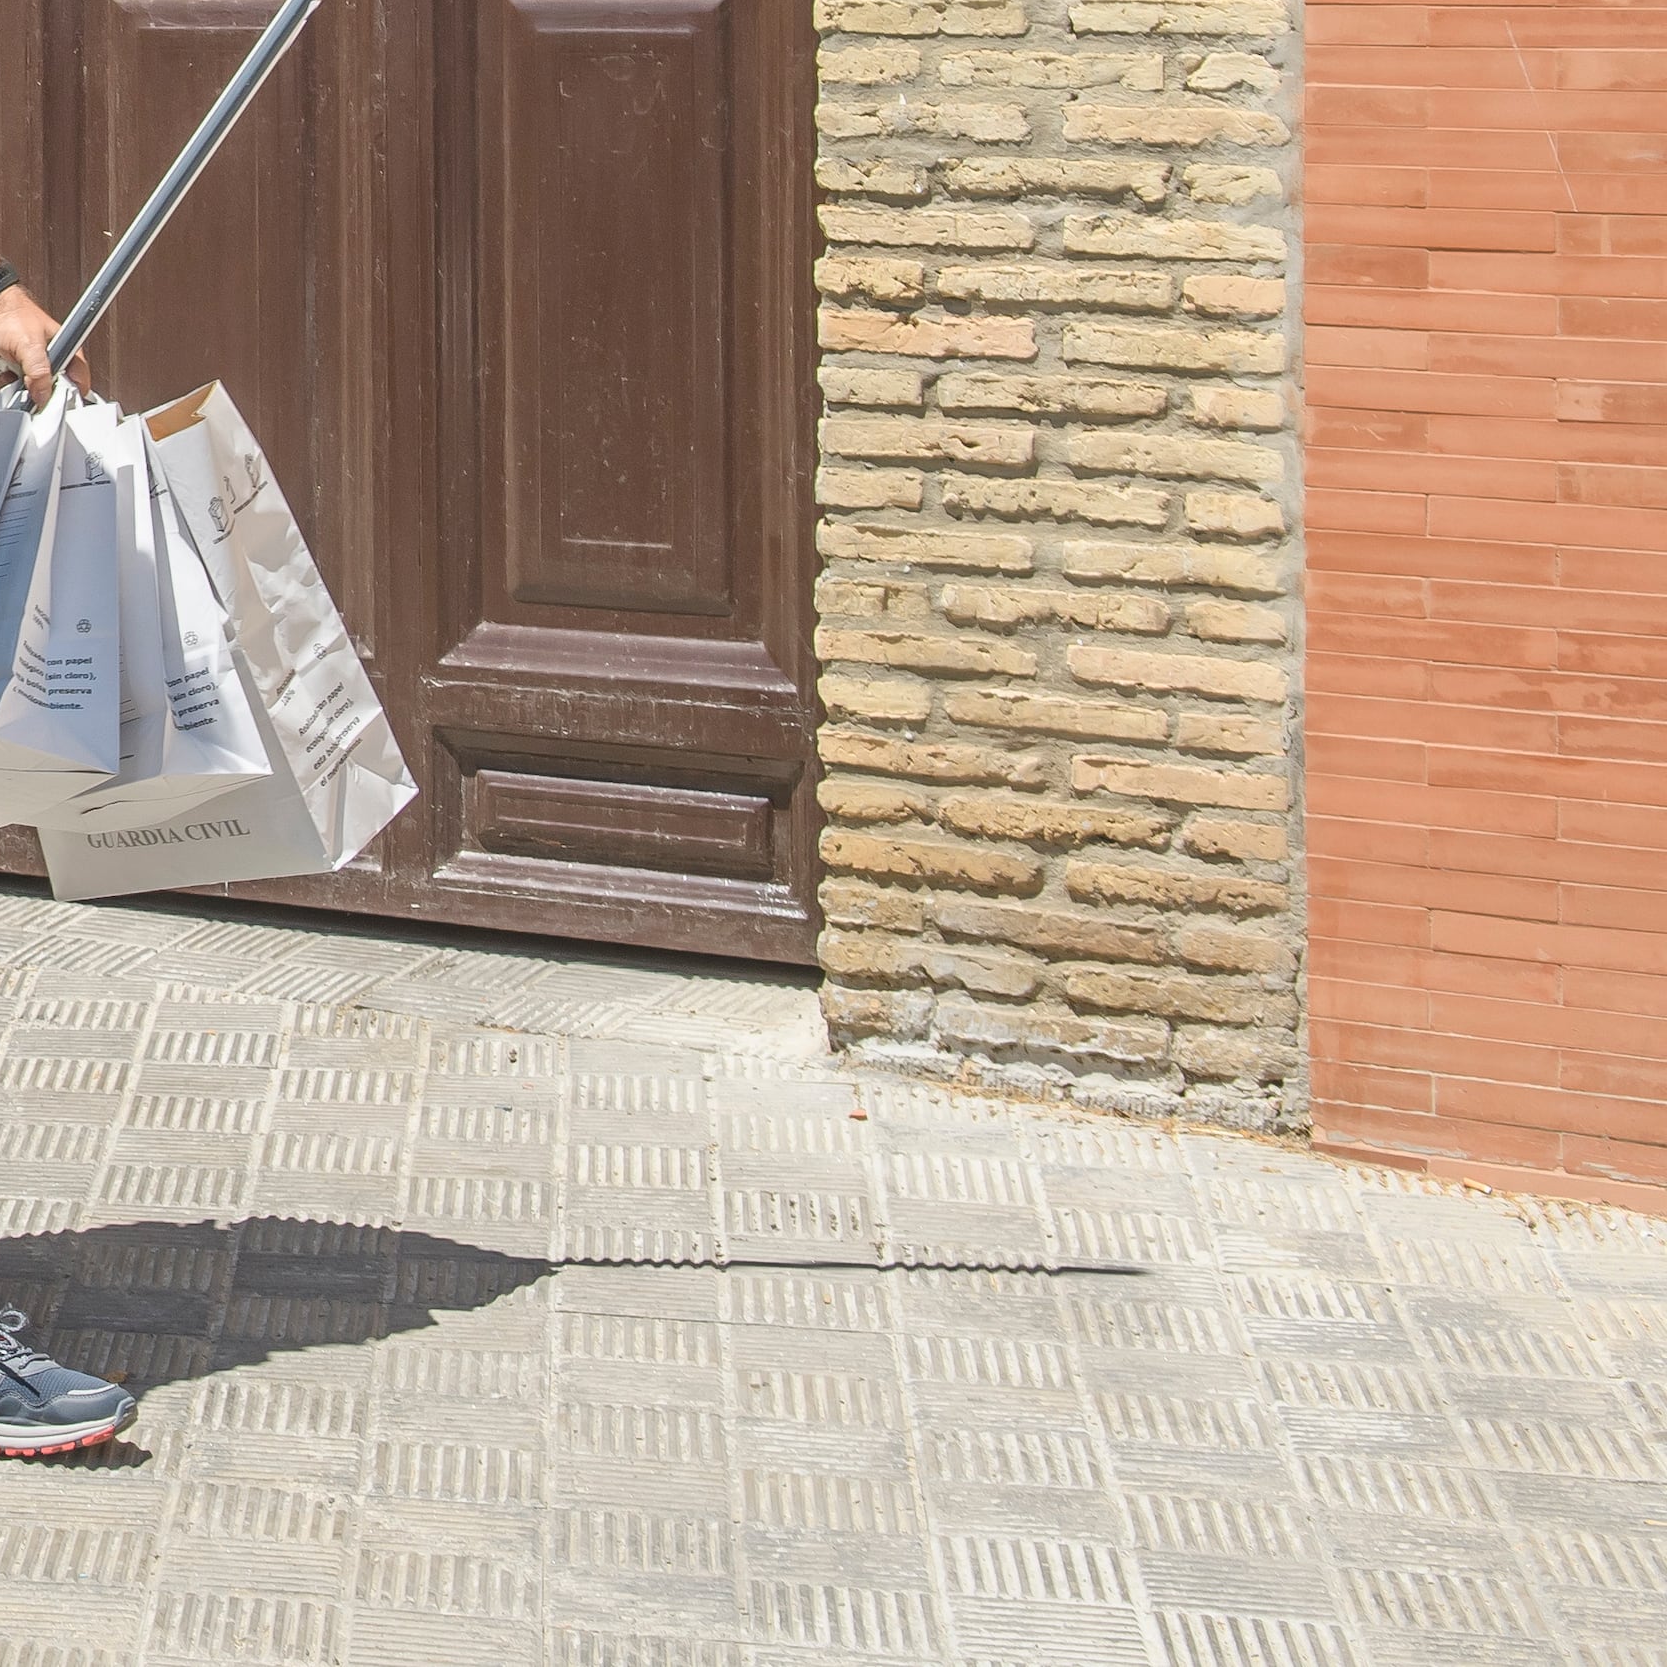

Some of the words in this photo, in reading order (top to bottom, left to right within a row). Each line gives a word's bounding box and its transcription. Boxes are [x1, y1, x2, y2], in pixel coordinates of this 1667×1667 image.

[47, 657, 63, 666] con
[65, 656, 93, 666] papel
[45, 672, 62, 681] (sin
[65, 671, 97, 681] cloro),
[184, 666, 210, 683] papel
[26, 678, 47, 694] bolsa
[48, 687, 93, 696] preserva
[177, 698, 220, 719] preserva
[87, 828, 184, 849] GUARDIA
[184, 819, 251, 841] CIVIL
